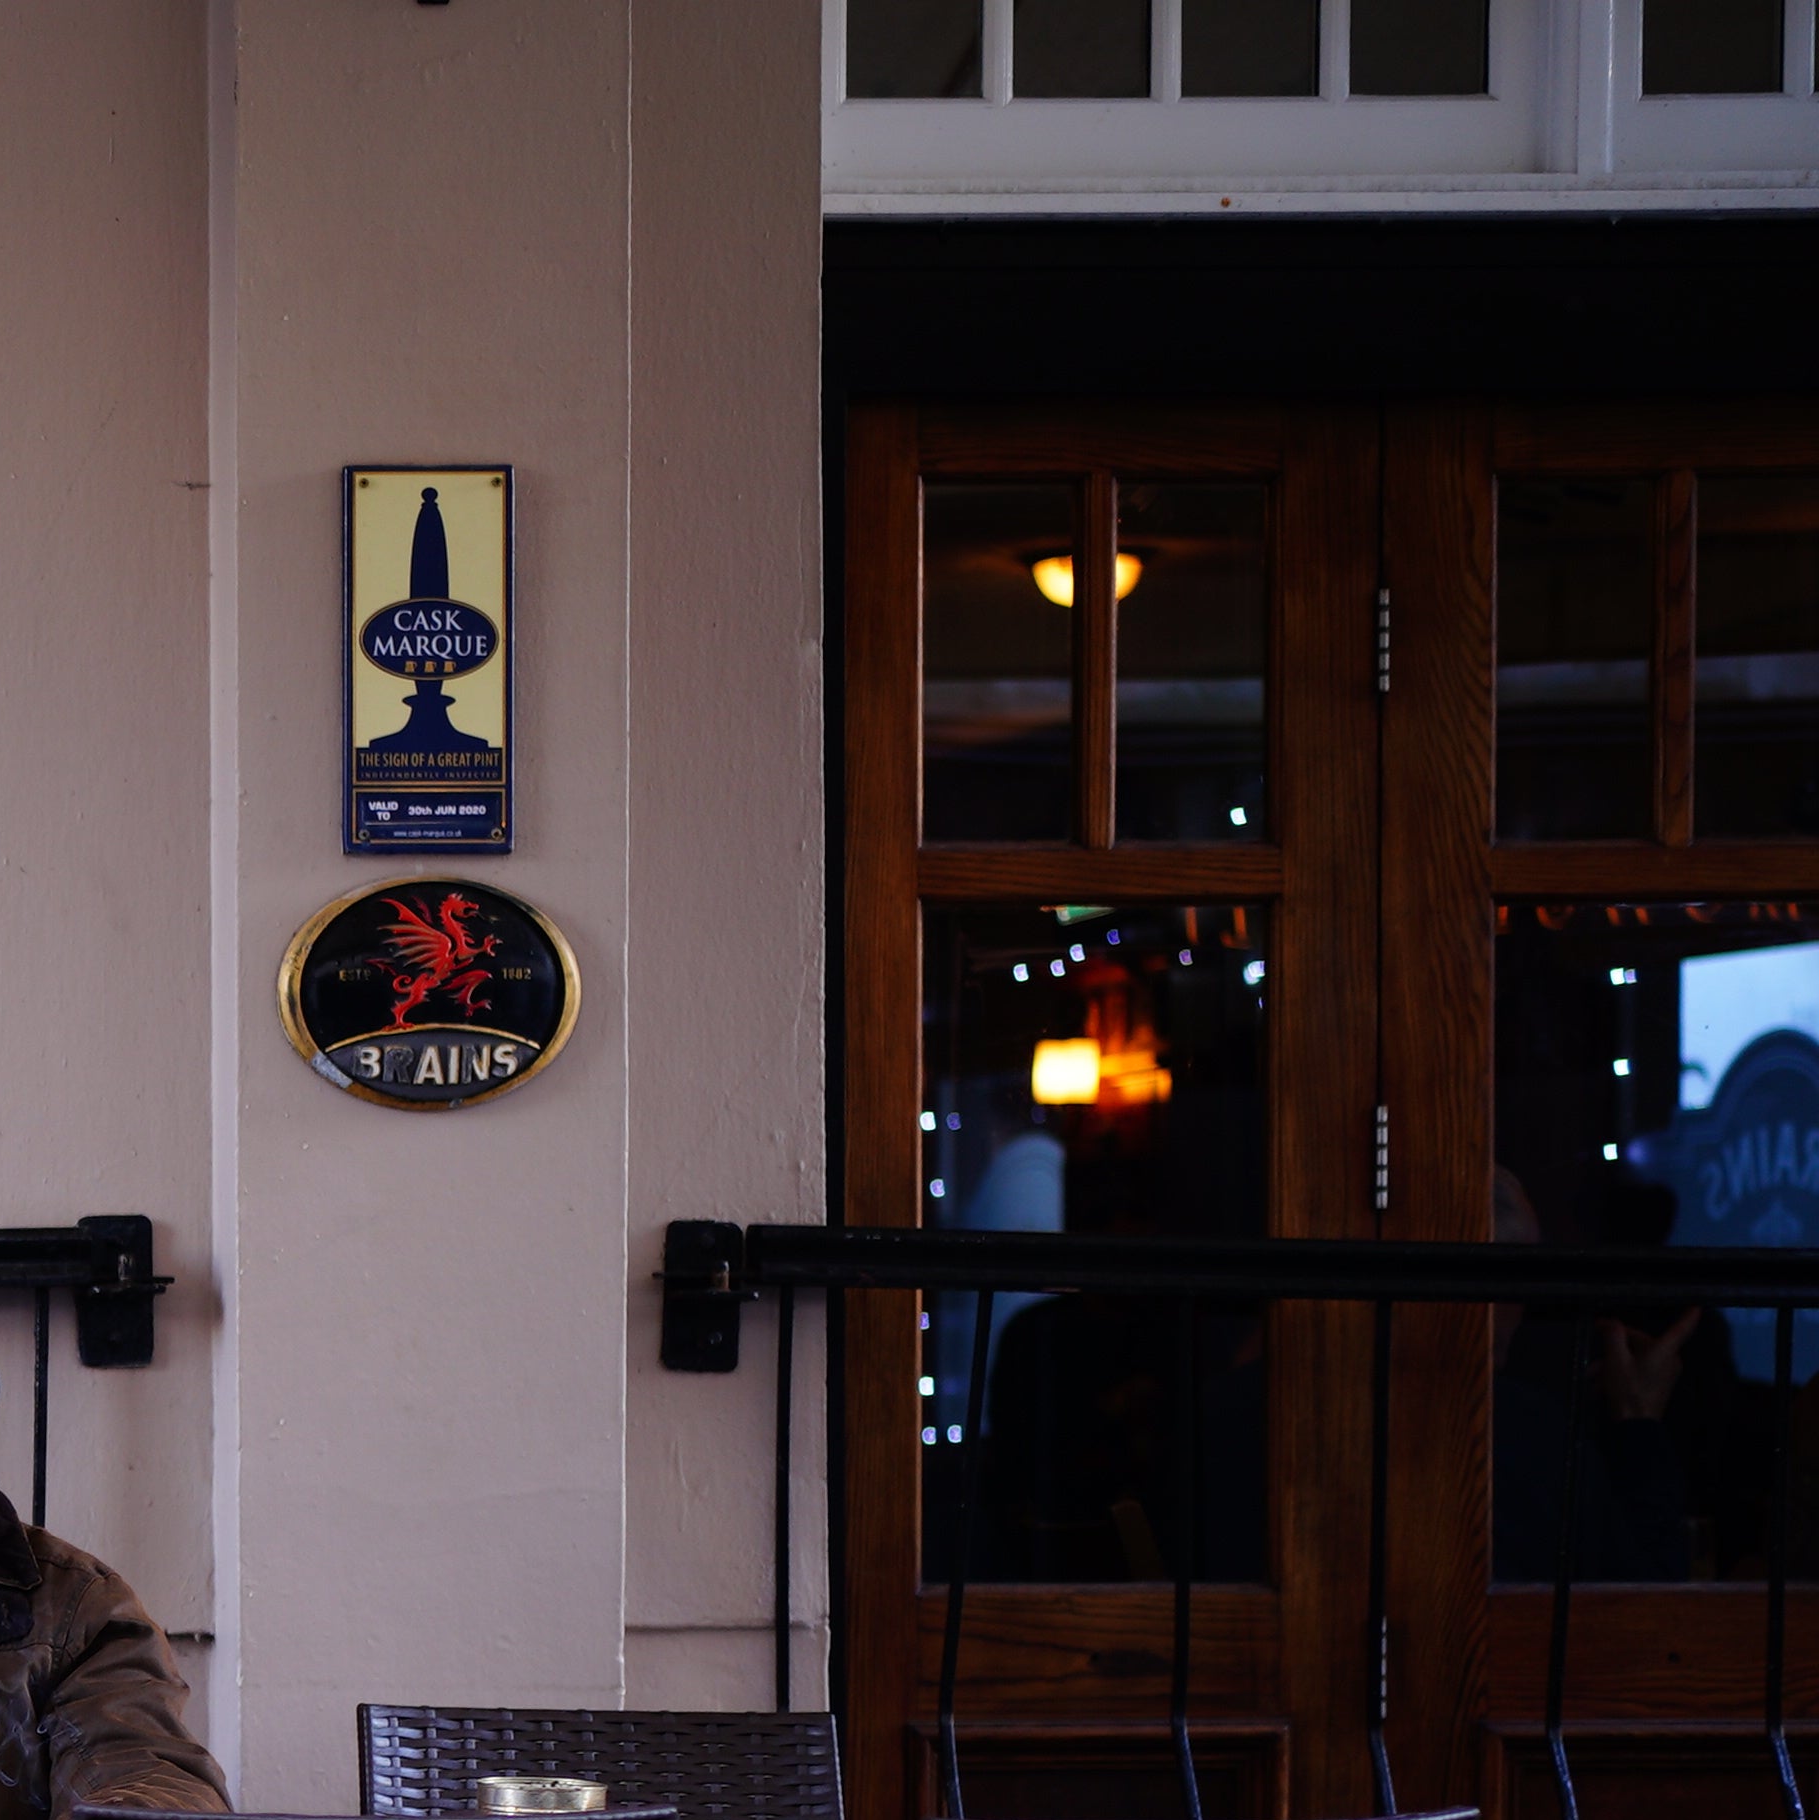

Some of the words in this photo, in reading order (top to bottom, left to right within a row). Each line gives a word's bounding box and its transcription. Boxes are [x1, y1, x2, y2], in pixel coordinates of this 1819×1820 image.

[394, 609, 463, 632] CASK
[373, 634, 488, 660] MARQUE
[360, 752, 380, 767] THE
[382, 752, 409, 767] SIGN
[412, 752, 425, 767] OF
[428, 752, 435, 767] A
[438, 752, 471, 767] GREAT
[474, 752, 500, 767] PINT
[361, 770, 440, 779] INDEPENDENTLY
[445, 770, 499, 779] INSPECTED
[368, 801, 399, 812] VALID
[408, 805, 433, 816] 30th
[434, 805, 457, 815] JUN
[459, 805, 487, 815] 2020
[377, 811, 391, 822] TO
[351, 1043, 520, 1086] BRAINS
